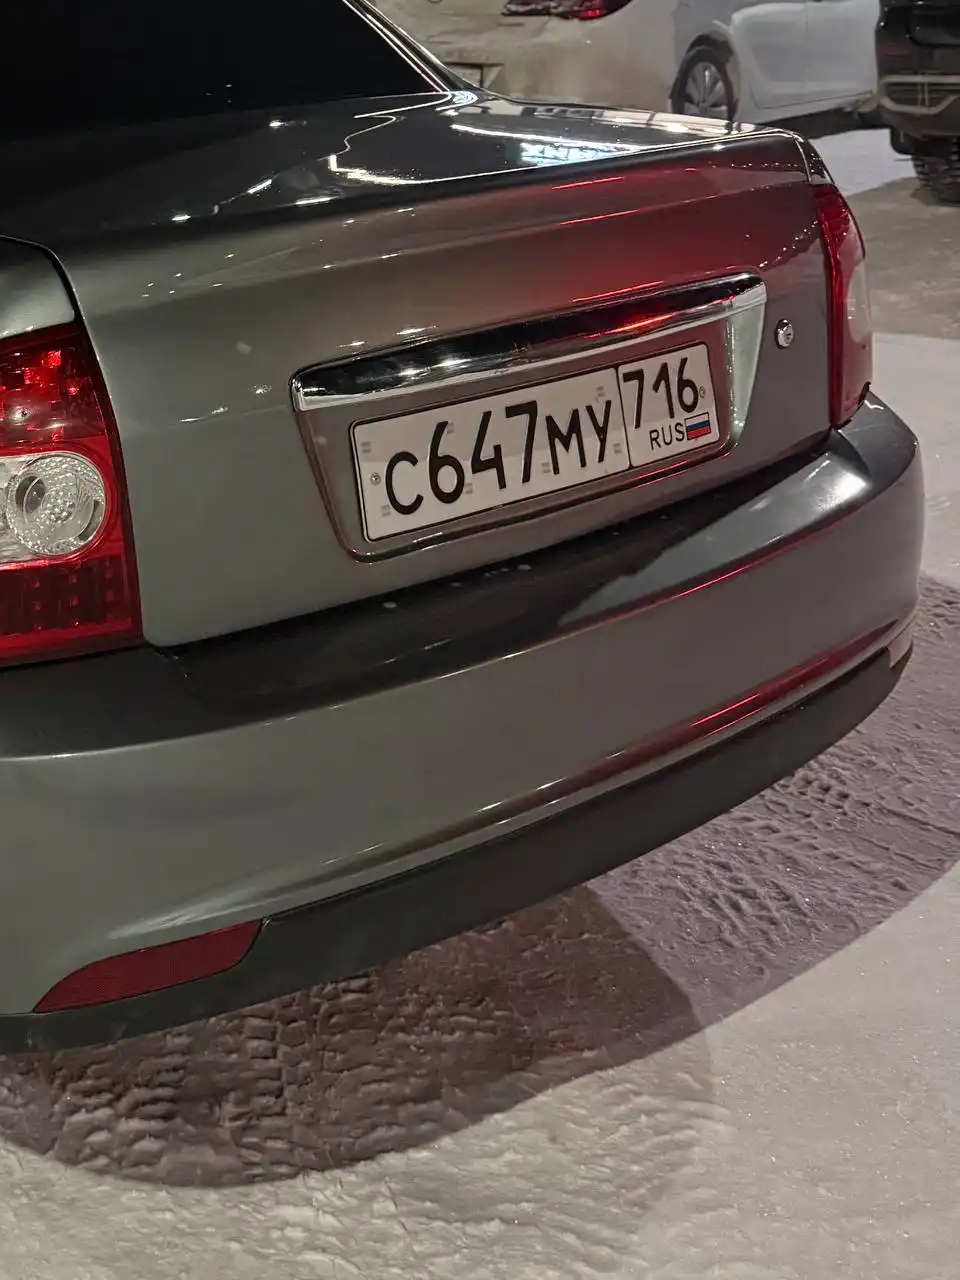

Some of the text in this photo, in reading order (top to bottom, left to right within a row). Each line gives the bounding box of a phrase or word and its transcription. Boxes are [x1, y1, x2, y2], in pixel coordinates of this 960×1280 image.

[385, 356, 700, 516] С647МУ 716
[649, 426, 686, 451] RUS
